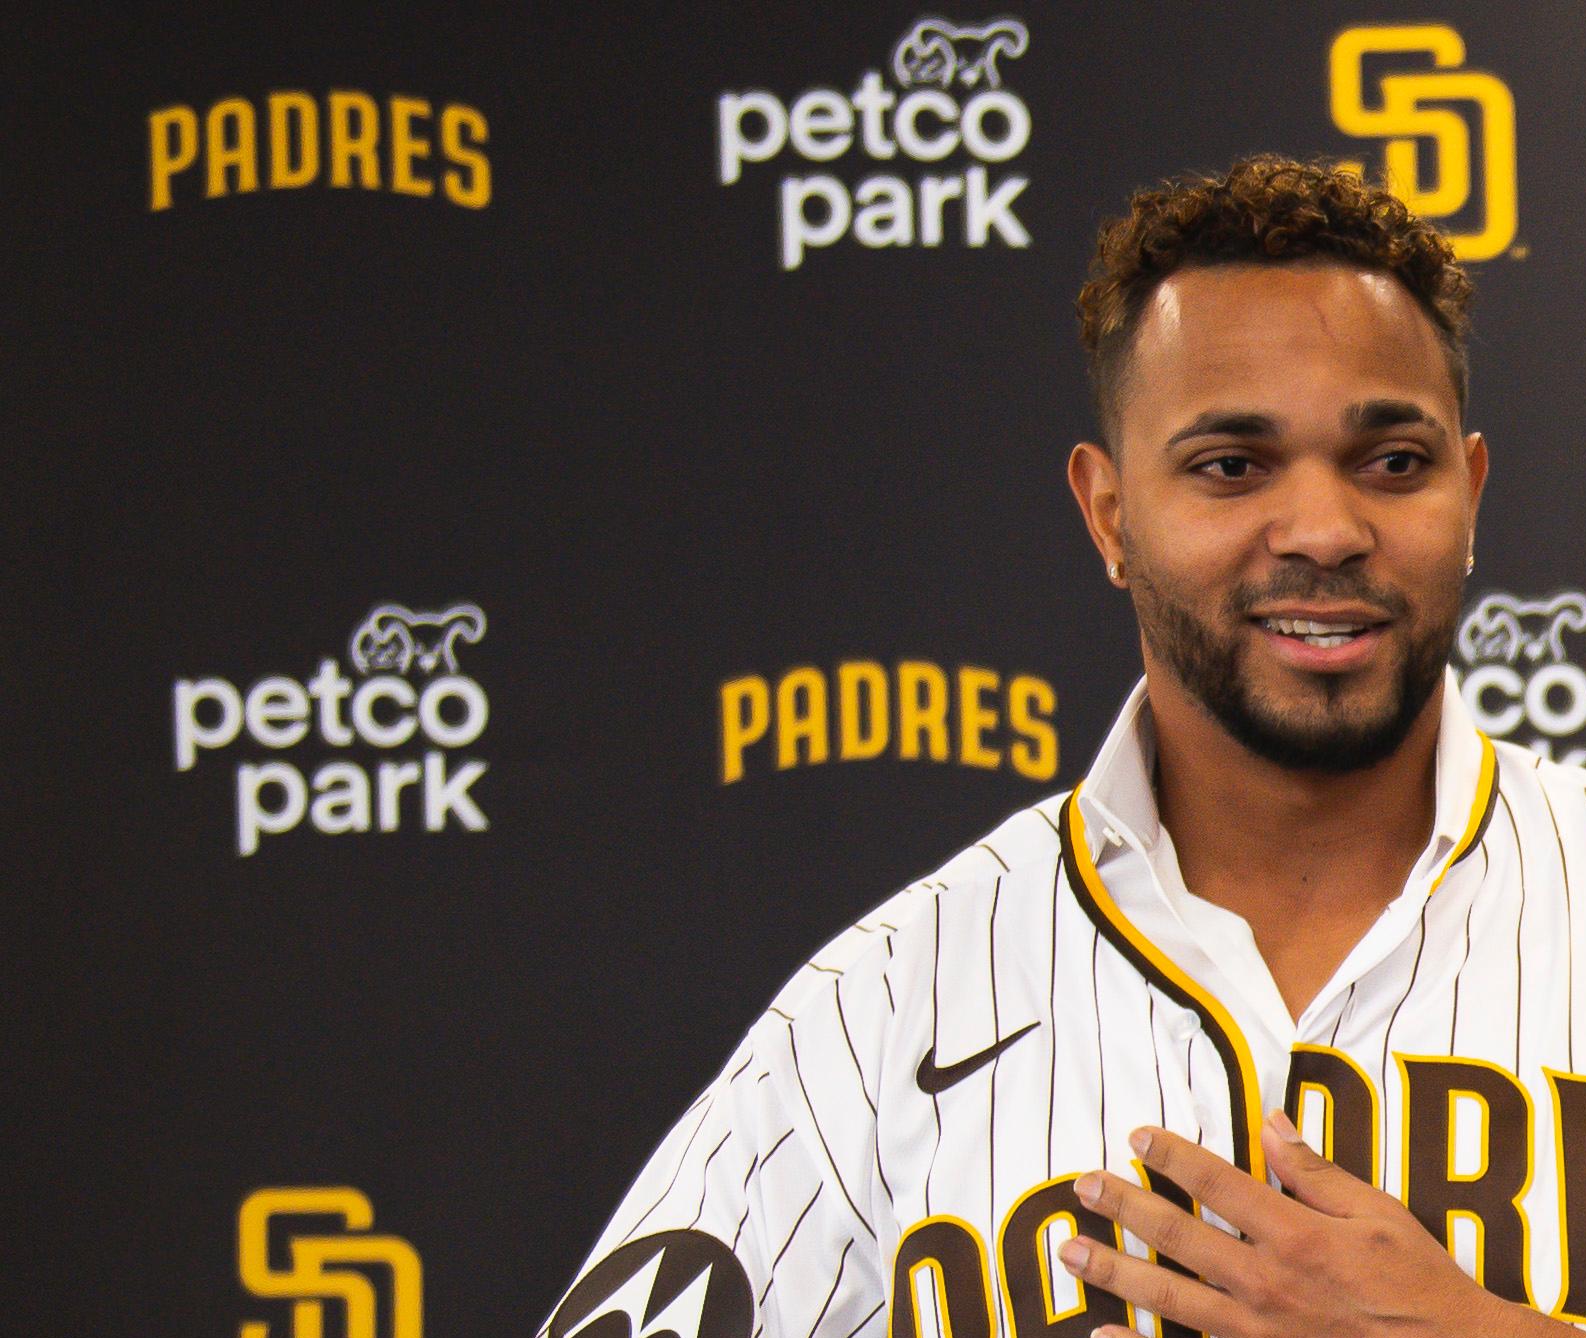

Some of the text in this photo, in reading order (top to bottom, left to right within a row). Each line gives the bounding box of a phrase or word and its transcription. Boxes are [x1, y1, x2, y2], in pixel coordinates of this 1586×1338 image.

[148, 89, 492, 212] PADRES
[719, 71, 1032, 185] petco
[780, 168, 1032, 270] park
[172, 658, 490, 772] petco
[720, 659, 1059, 786] PADRES
[234, 750, 490, 857] park
